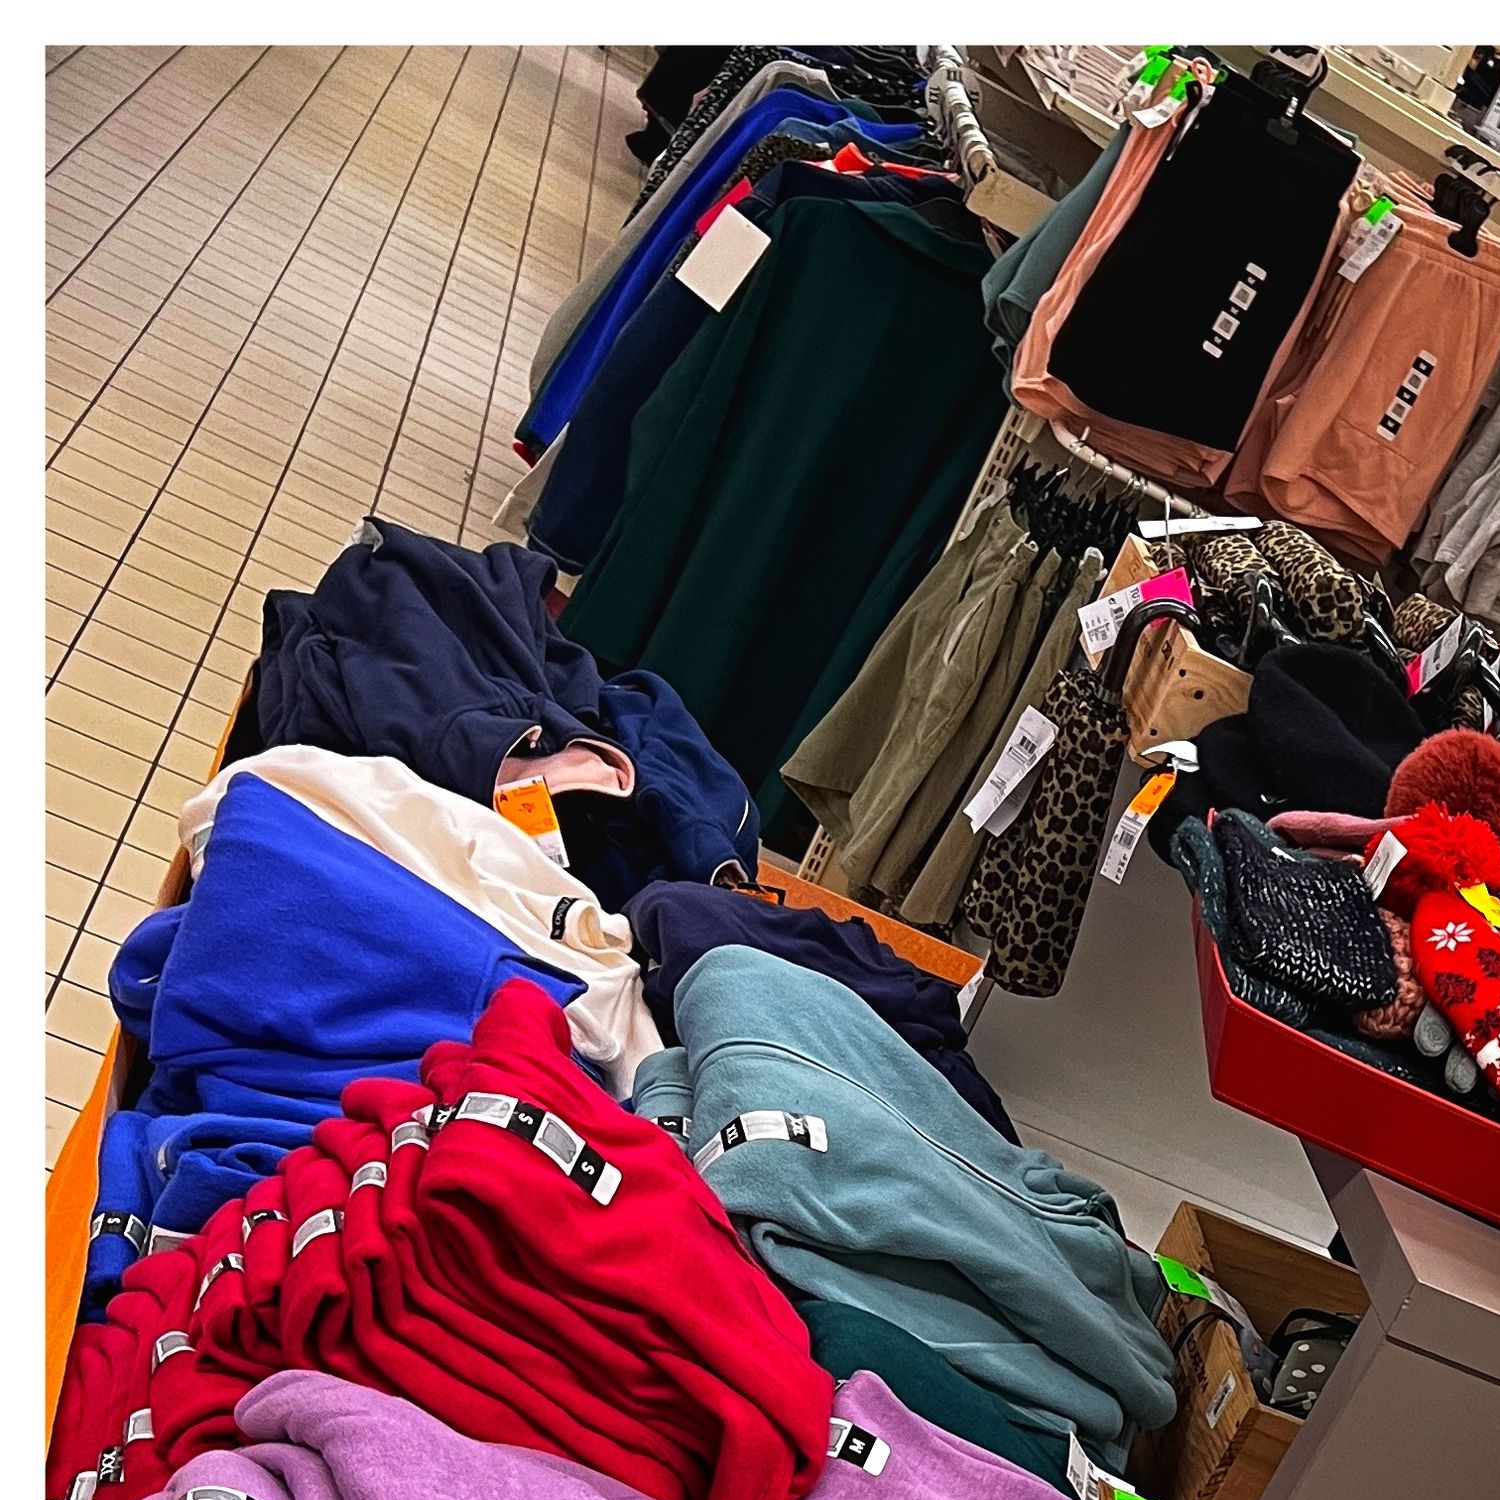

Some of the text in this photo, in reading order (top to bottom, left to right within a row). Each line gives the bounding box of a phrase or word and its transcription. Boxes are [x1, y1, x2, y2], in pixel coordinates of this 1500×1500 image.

[518, 1112, 534, 1125] S
[581, 1160, 595, 1176] S
[107, 1217, 121, 1225] S
[849, 1438, 865, 1454] M
